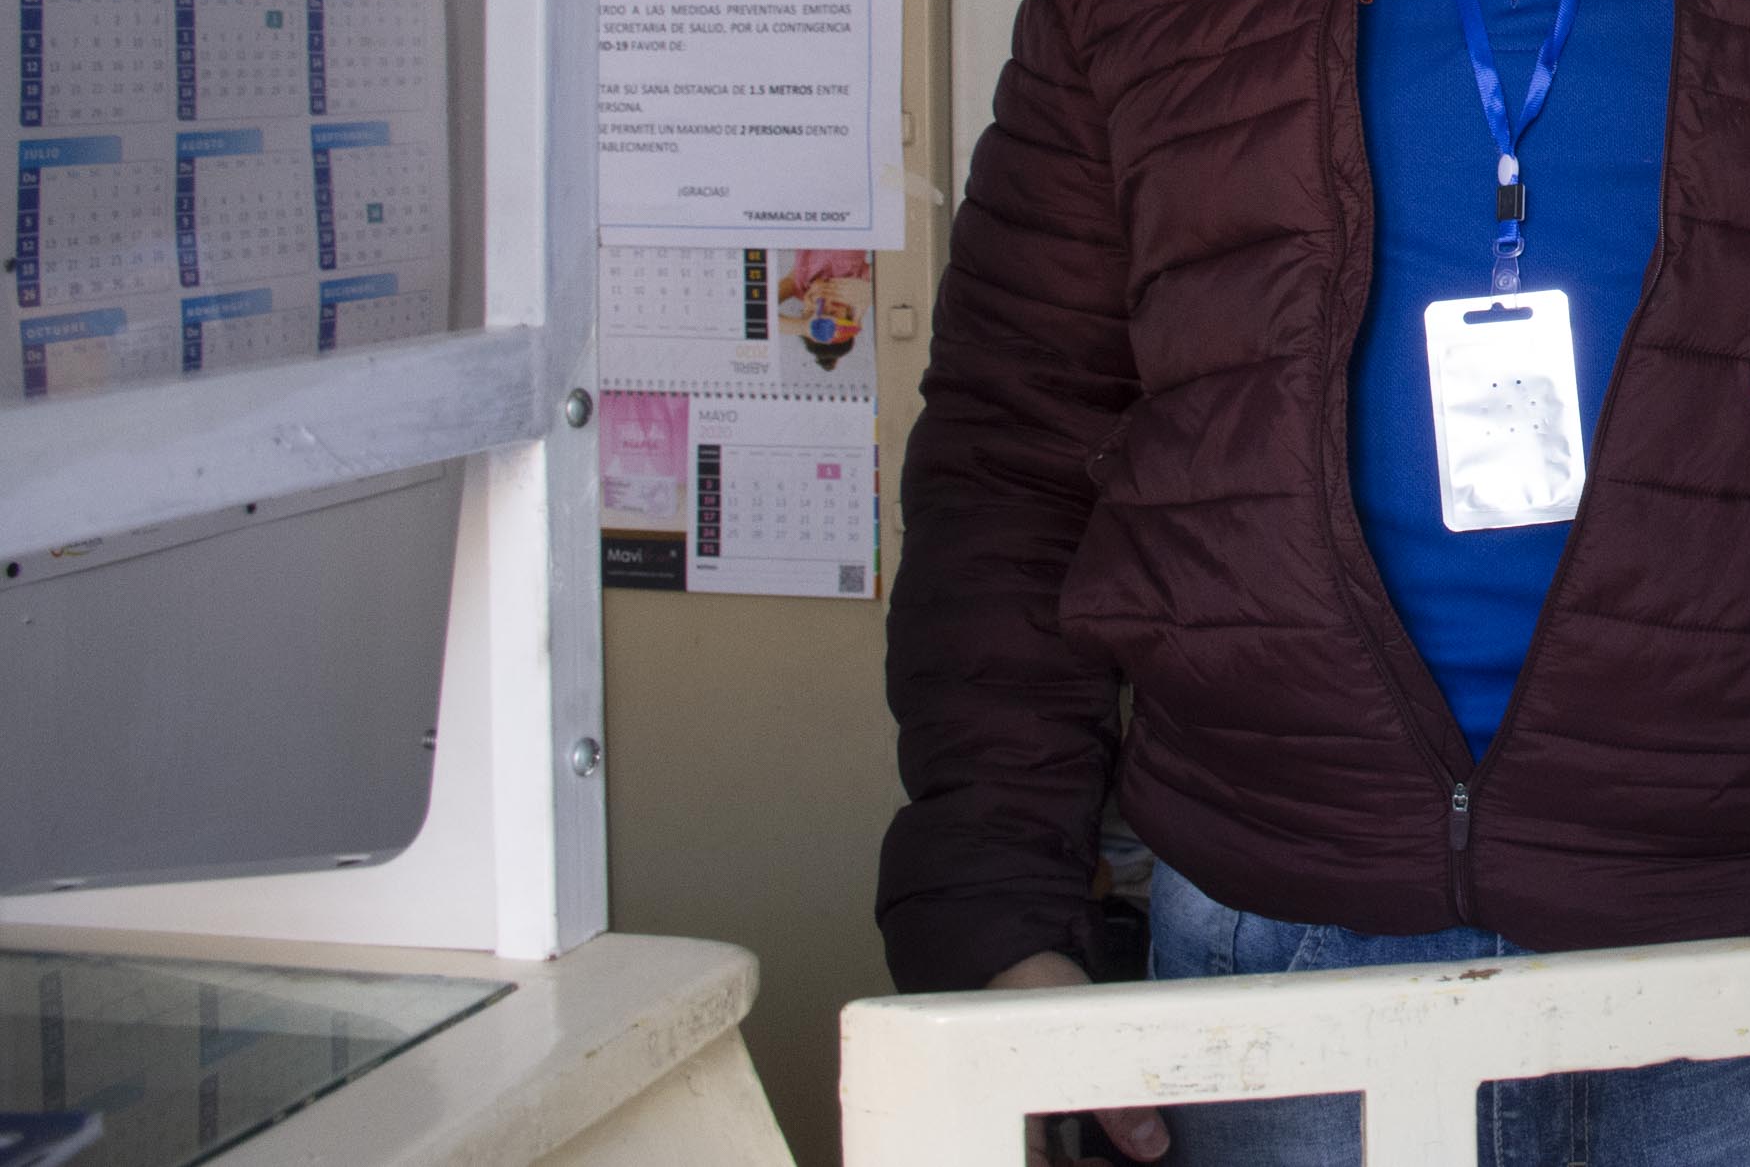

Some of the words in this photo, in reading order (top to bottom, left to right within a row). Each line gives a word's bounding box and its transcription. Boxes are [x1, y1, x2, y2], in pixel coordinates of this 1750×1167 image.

[632, 5, 640, 15] A
[646, 5, 665, 16] LAS
[671, 5, 721, 16] MEDIDAS
[726, 4, 796, 16] PREVENTIVAS
[802, 4, 852, 16] EMITIDAS
[603, 22, 667, 34] SECRETARIA
[671, 22, 685, 33] DE
[730, 22, 752, 34] POR
[756, 22, 769, 33] LA
[772, 22, 851, 34] CONTINGENCIA
[631, 40, 667, 51] FAVOR
[624, 84, 638, 95] SU
[641, 84, 670, 95] SANA
[673, 84, 729, 95] DISTANCIA
[732, 84, 745, 95] DE
[749, 84, 765, 95] 1.5
[768, 84, 813, 96] METROS
[816, 84, 850, 96] ENTRE
[611, 124, 656, 135] PERMITE
[658, 124, 674, 135] UN
[677, 124, 723, 136] MAXIMO
[725, 124, 738, 136] DE
[749, 124, 804, 136] PERSONAS
[805, 124, 849, 136] DENTRO
[24, 147, 60, 161] JULIO
[805, 211, 818, 221] DE
[698, 409, 739, 423] MAYO
[606, 547, 643, 564] Mavi
